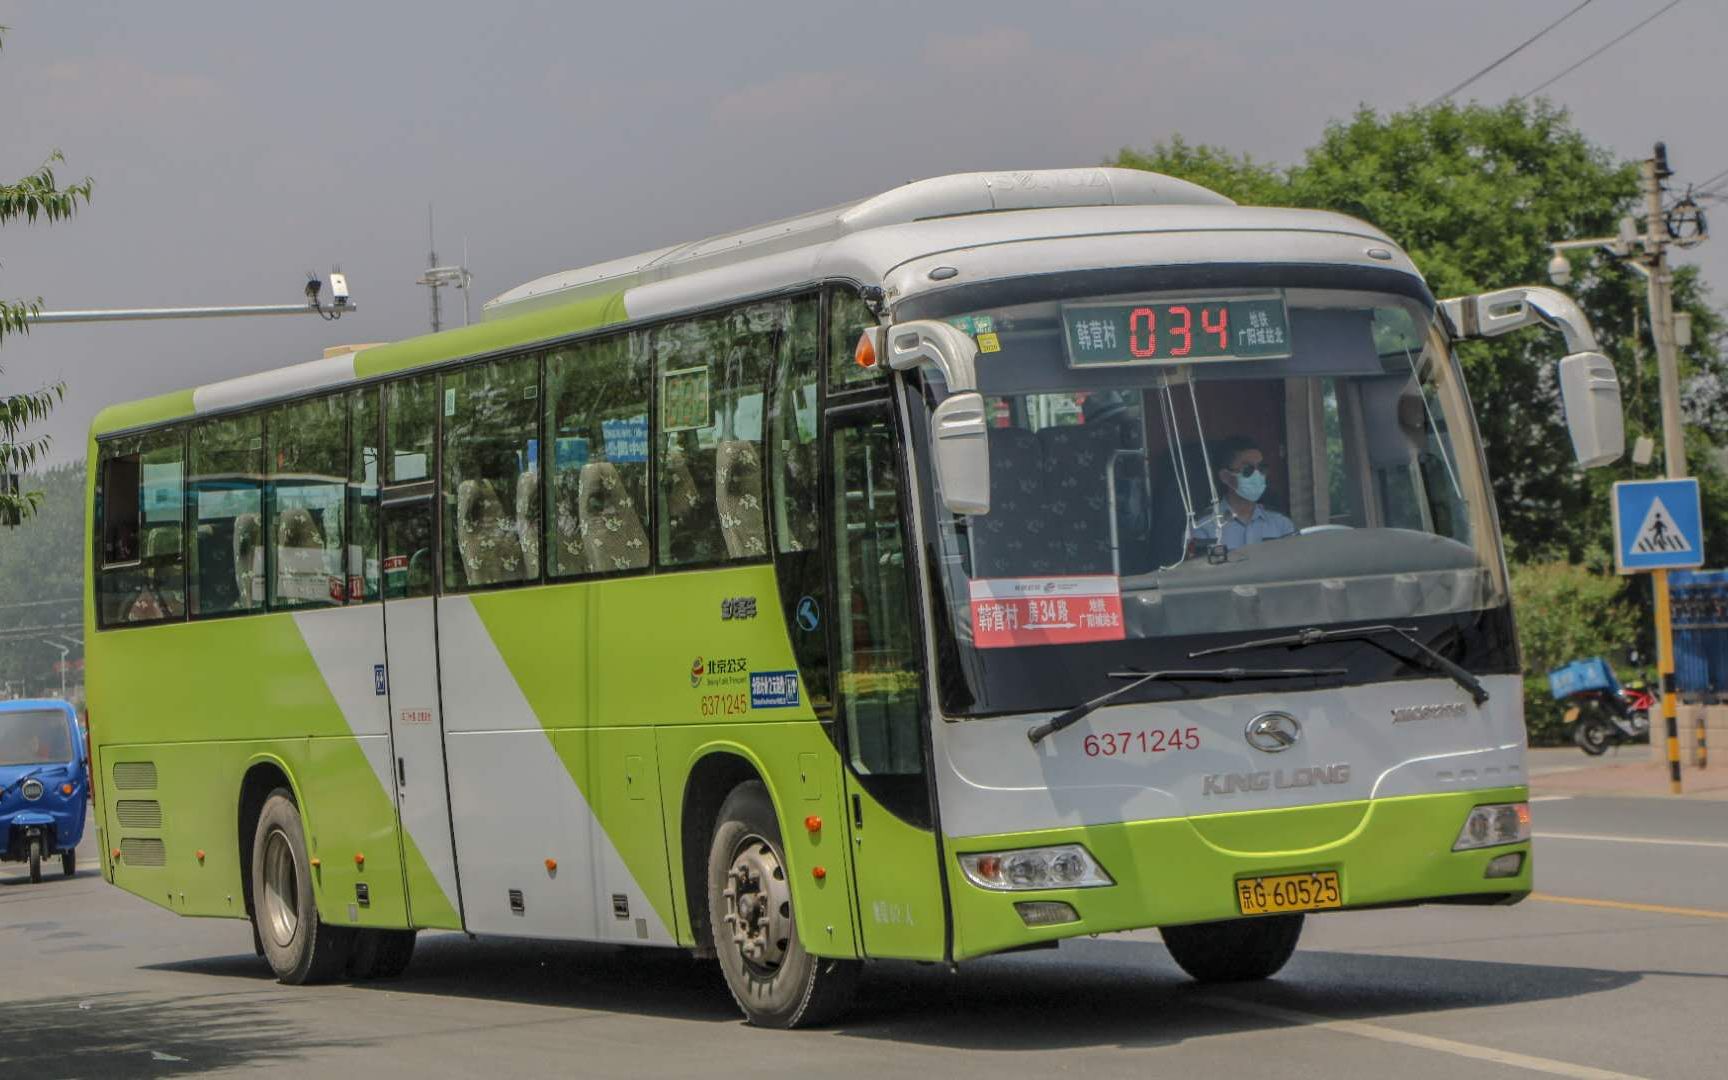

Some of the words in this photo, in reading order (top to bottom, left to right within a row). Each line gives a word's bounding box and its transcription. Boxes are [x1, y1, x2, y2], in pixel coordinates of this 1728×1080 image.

[1075, 319, 1117, 350] 韩营村
[1130, 306, 1228, 358] 034
[707, 658, 747, 675] 北京公交
[702, 695, 747, 716] 6371245
[1083, 727, 1200, 757] 6371245
[1202, 771, 1271, 796] KING
[1275, 764, 1350, 789] LONG
